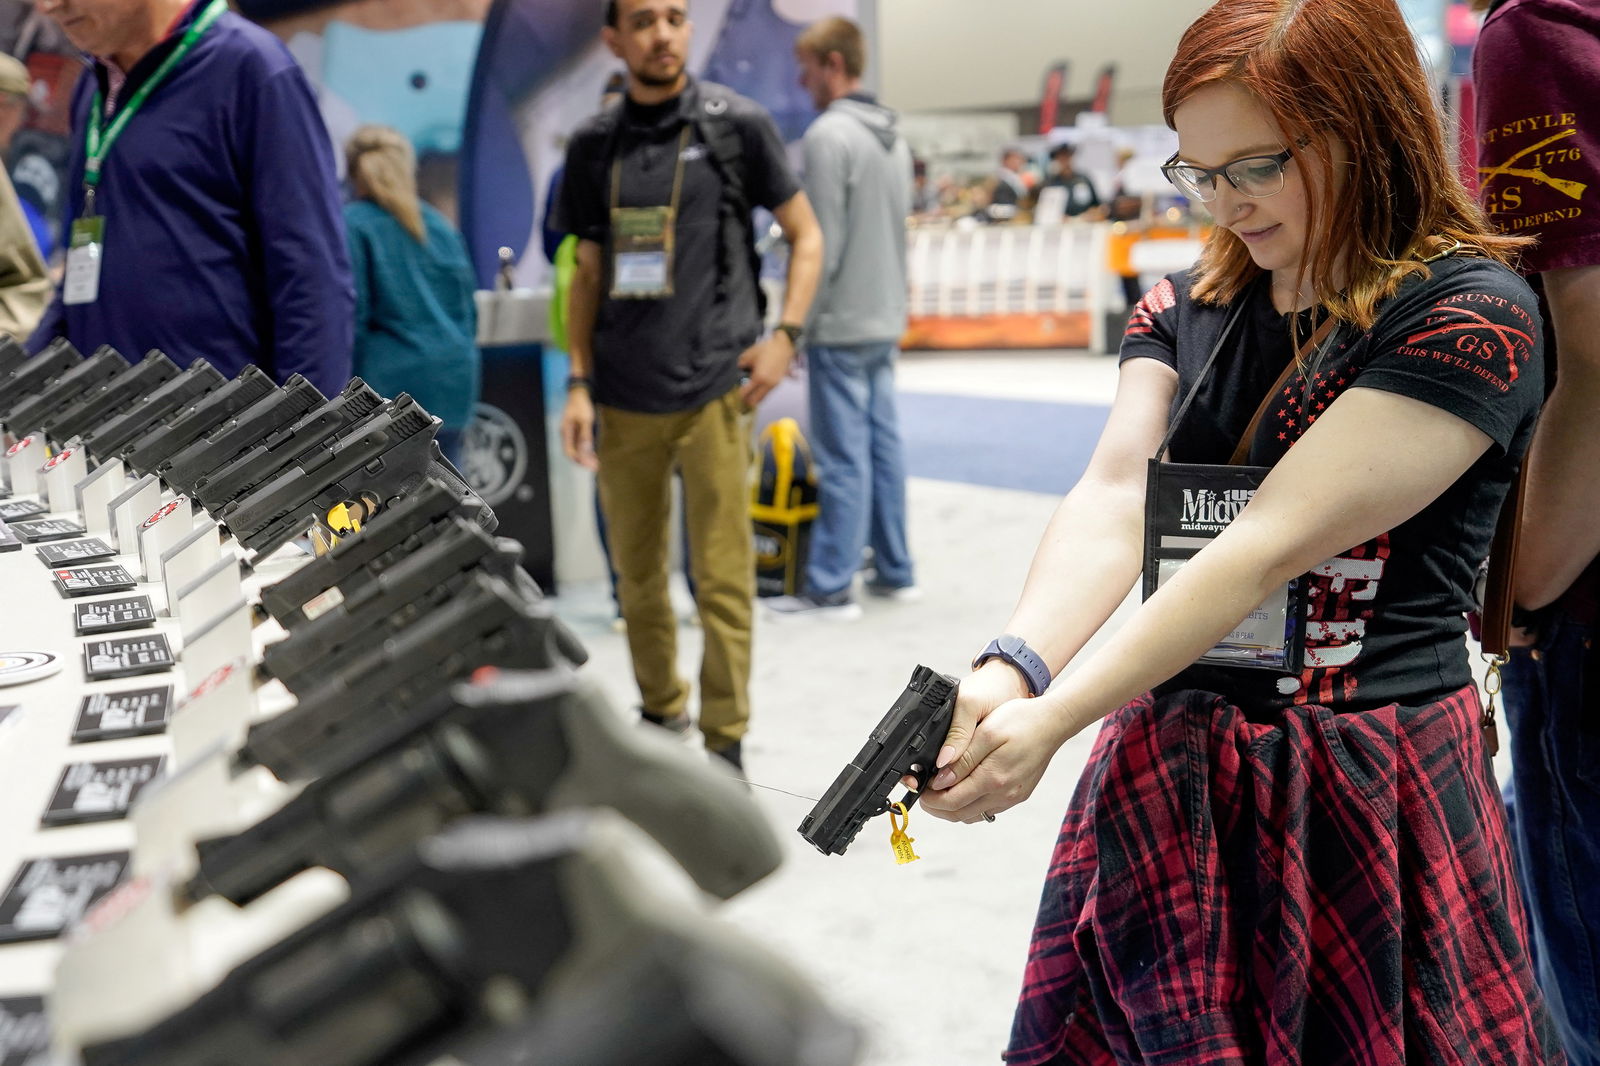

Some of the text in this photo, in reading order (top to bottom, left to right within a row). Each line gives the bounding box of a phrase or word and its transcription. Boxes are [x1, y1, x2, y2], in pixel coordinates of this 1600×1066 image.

[1502, 113, 1576, 137] STYLE
[1533, 148, 1581, 167] 1776
[1486, 186, 1522, 214] GS
[1513, 207, 1581, 230] DEFEND
[1456, 334, 1498, 360] GS
[1396, 346, 1509, 392] THIS WE'LL DEFEND
[1181, 523, 1227, 533] midwayu
